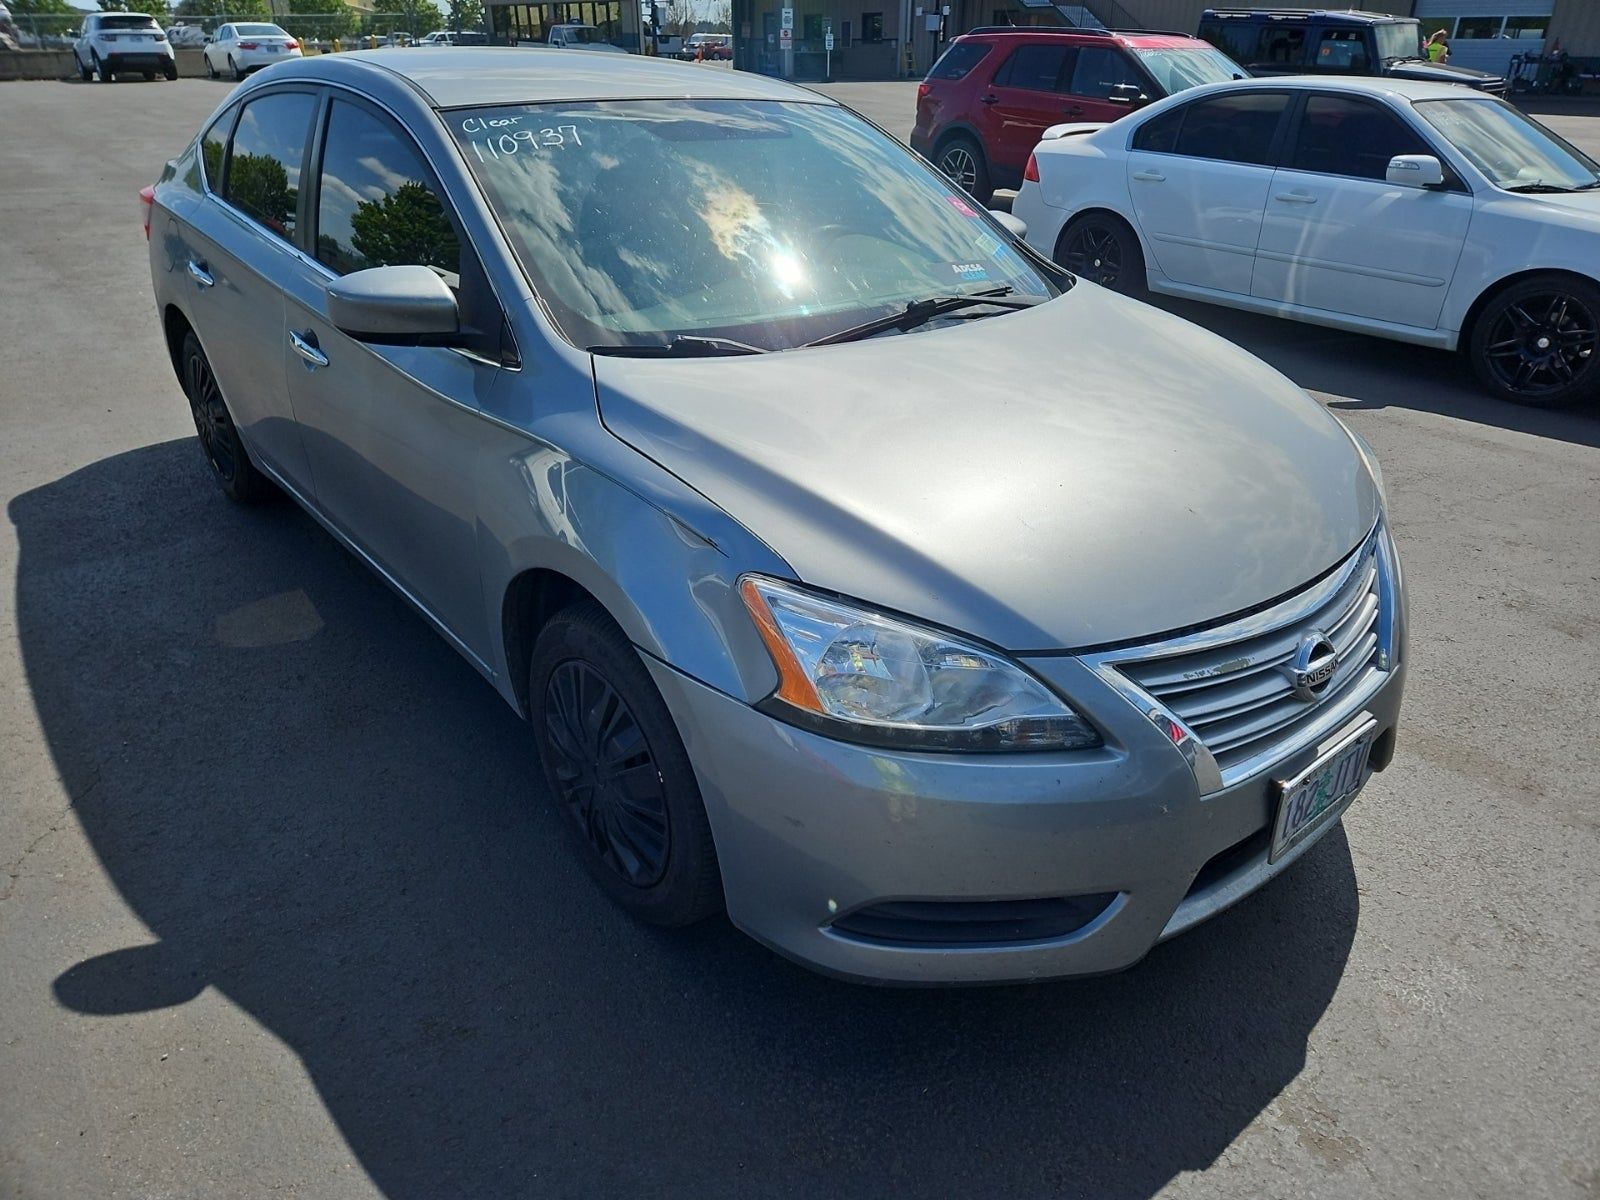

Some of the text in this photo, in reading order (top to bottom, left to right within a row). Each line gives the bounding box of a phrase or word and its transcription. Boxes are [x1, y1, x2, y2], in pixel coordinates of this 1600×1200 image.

[462, 116, 524, 133] Clear
[472, 124, 583, 164] 110937
[1306, 659, 1339, 684] NISSAN
[1281, 778, 1321, 841] 182
